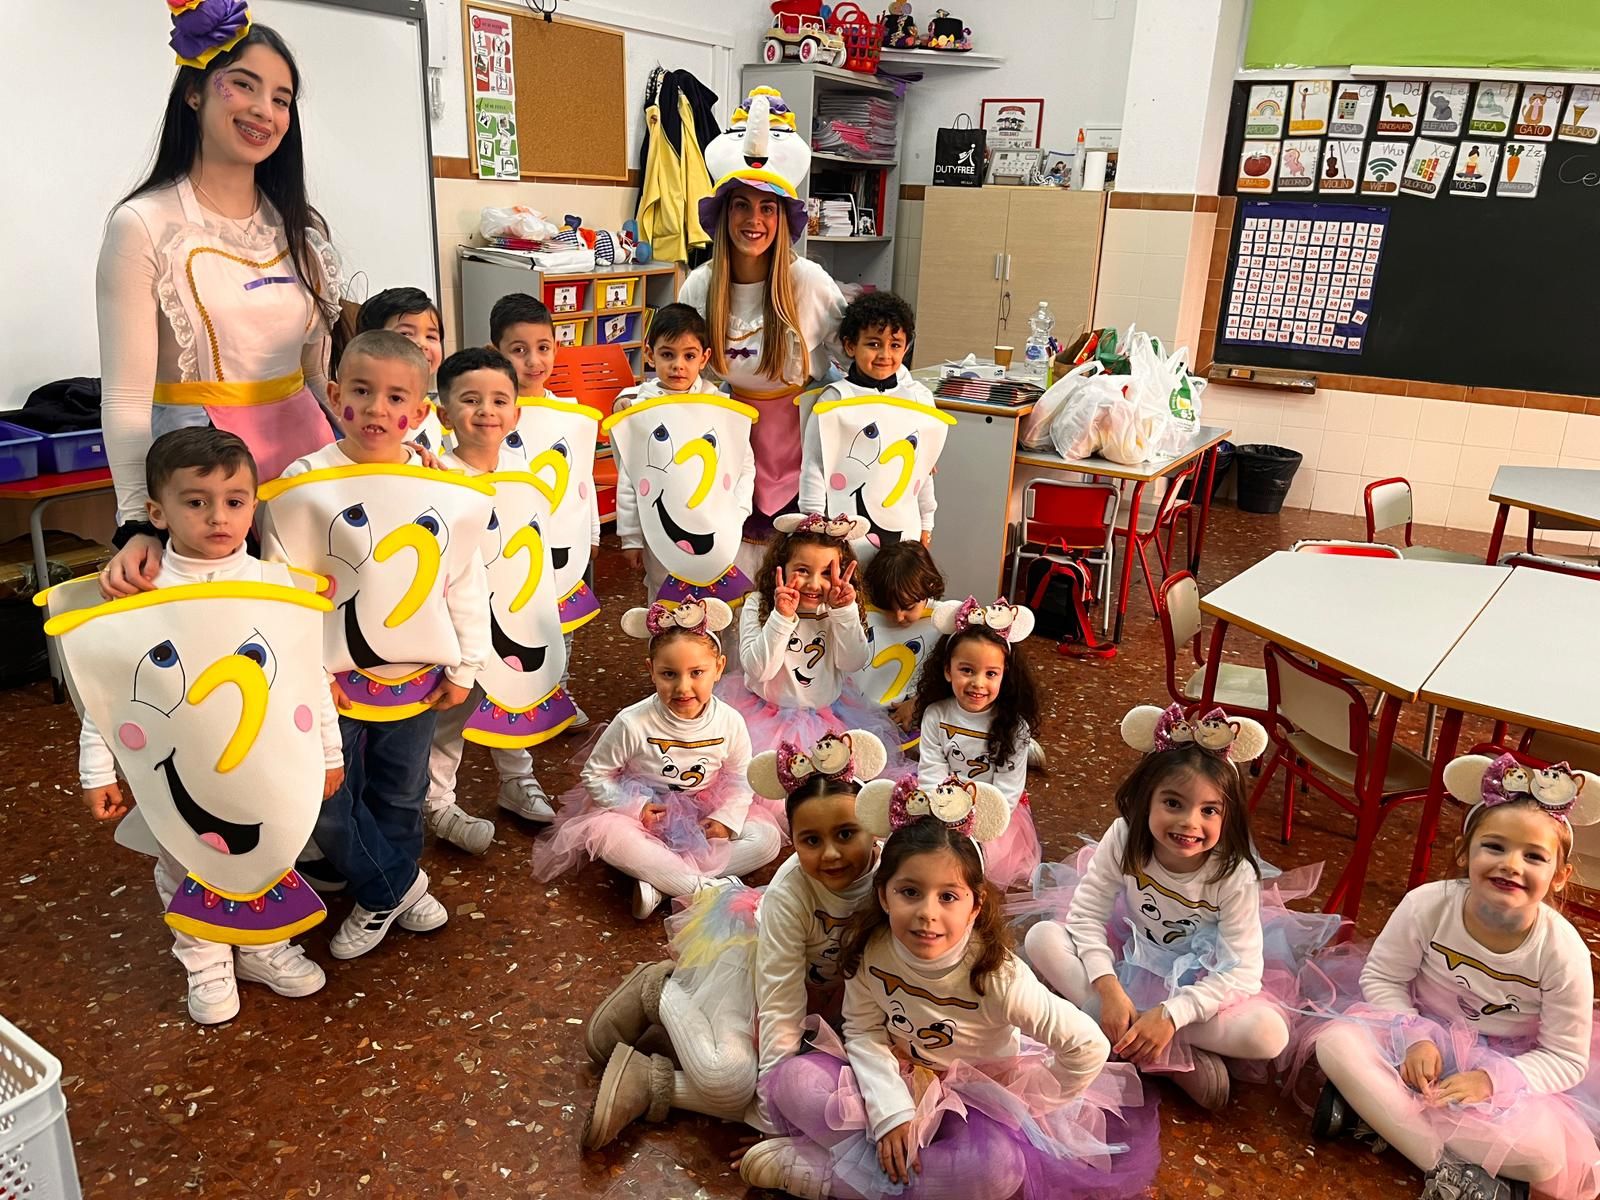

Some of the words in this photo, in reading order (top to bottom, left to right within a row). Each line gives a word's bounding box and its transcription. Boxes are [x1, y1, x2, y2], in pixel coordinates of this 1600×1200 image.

[1268, 87, 1285, 98] Aa
[1313, 82, 1330, 94] Bb
[1358, 86, 1373, 98] Cc
[1403, 82, 1422, 96] Dd
[1545, 86, 1562, 104] Gg
[1334, 124, 1357, 132] CASA
[1423, 122, 1456, 131] ELEFANTE
[1474, 121, 1497, 130] FOCA
[1519, 125, 1545, 135] GATO
[1562, 126, 1594, 136] HELADO
[1342, 143, 1360, 154] Vv
[1383, 144, 1404, 155] Ww
[1432, 144, 1451, 158] Xx
[1484, 146, 1496, 162] Yy
[1525, 144, 1542, 157] Zz
[936, 165, 975, 174] DUTYFREE
[1370, 182, 1387, 191] WIFI
[1454, 182, 1476, 190] YOGA
